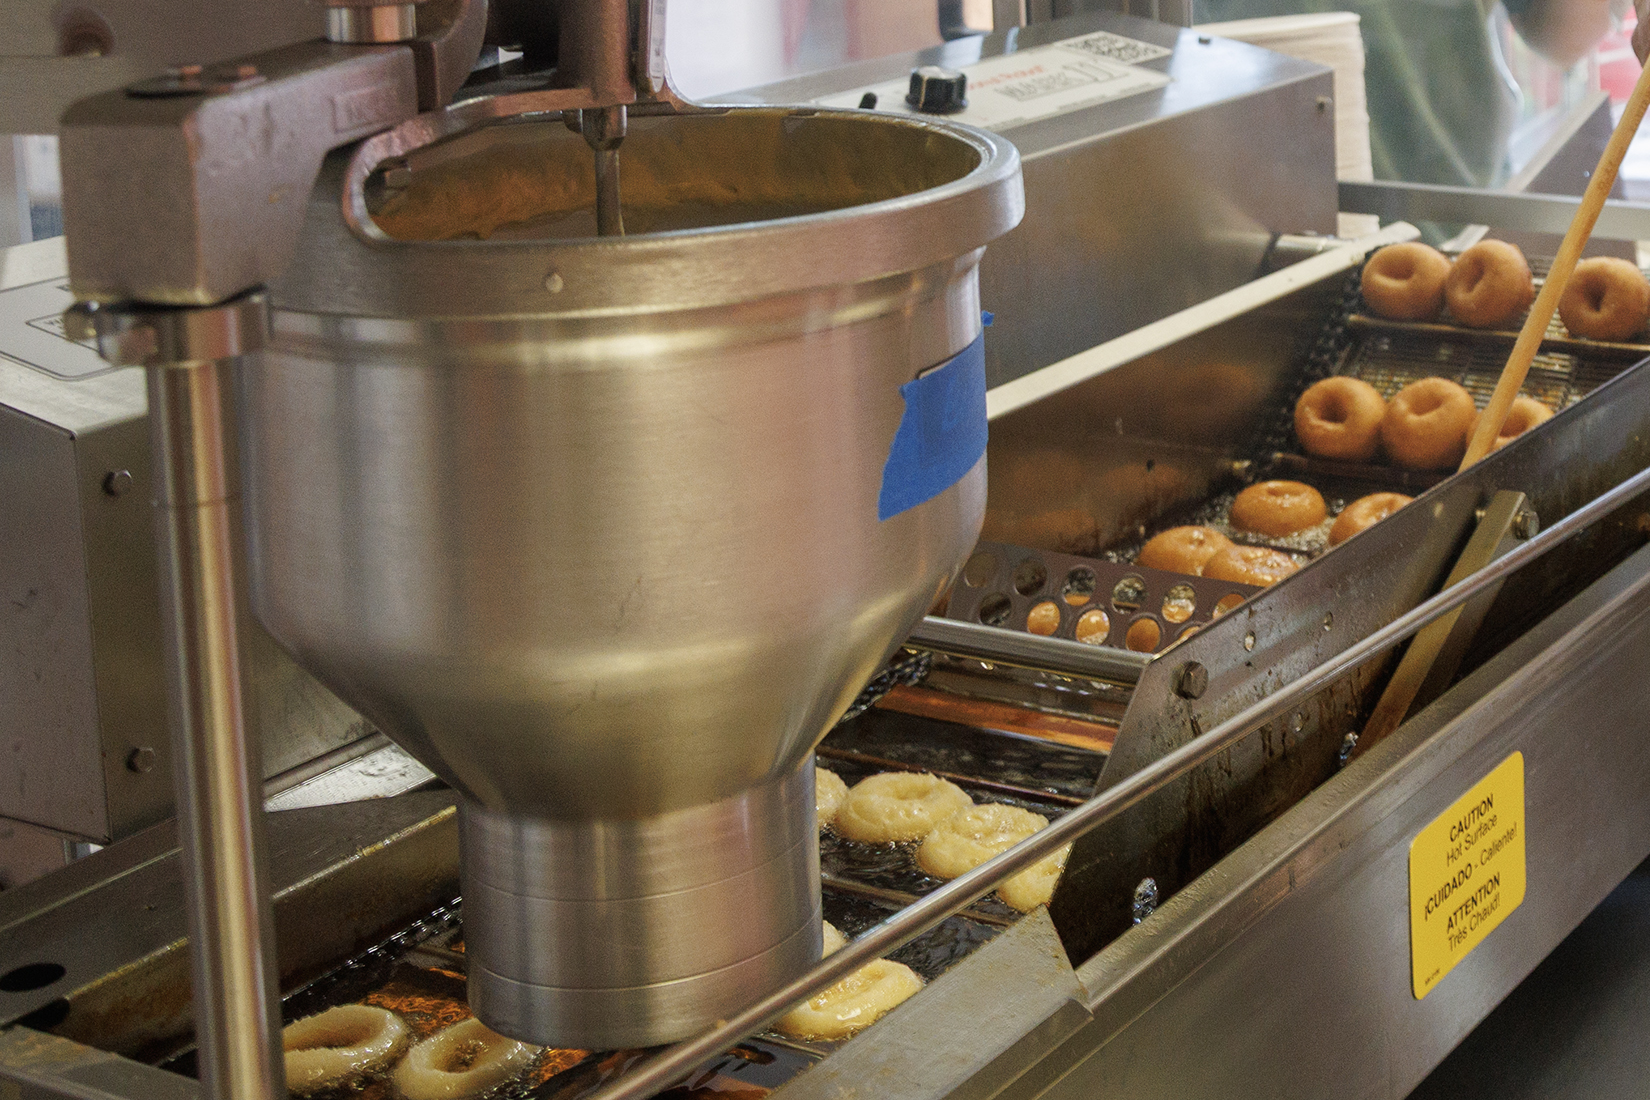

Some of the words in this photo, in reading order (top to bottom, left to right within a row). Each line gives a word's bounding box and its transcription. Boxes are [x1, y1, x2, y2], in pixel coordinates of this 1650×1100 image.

[1446, 845, 1463, 868] Hot
[1464, 813, 1498, 853] Surface
[1449, 793, 1494, 843] CAUTION
[1424, 862, 1473, 922] ¡CUIDADO
[1479, 822, 1519, 868] Caliente!
[1446, 871, 1501, 934] ATTENTION
[1448, 928, 1468, 953] Très
[1469, 894, 1501, 932] Chaud!
